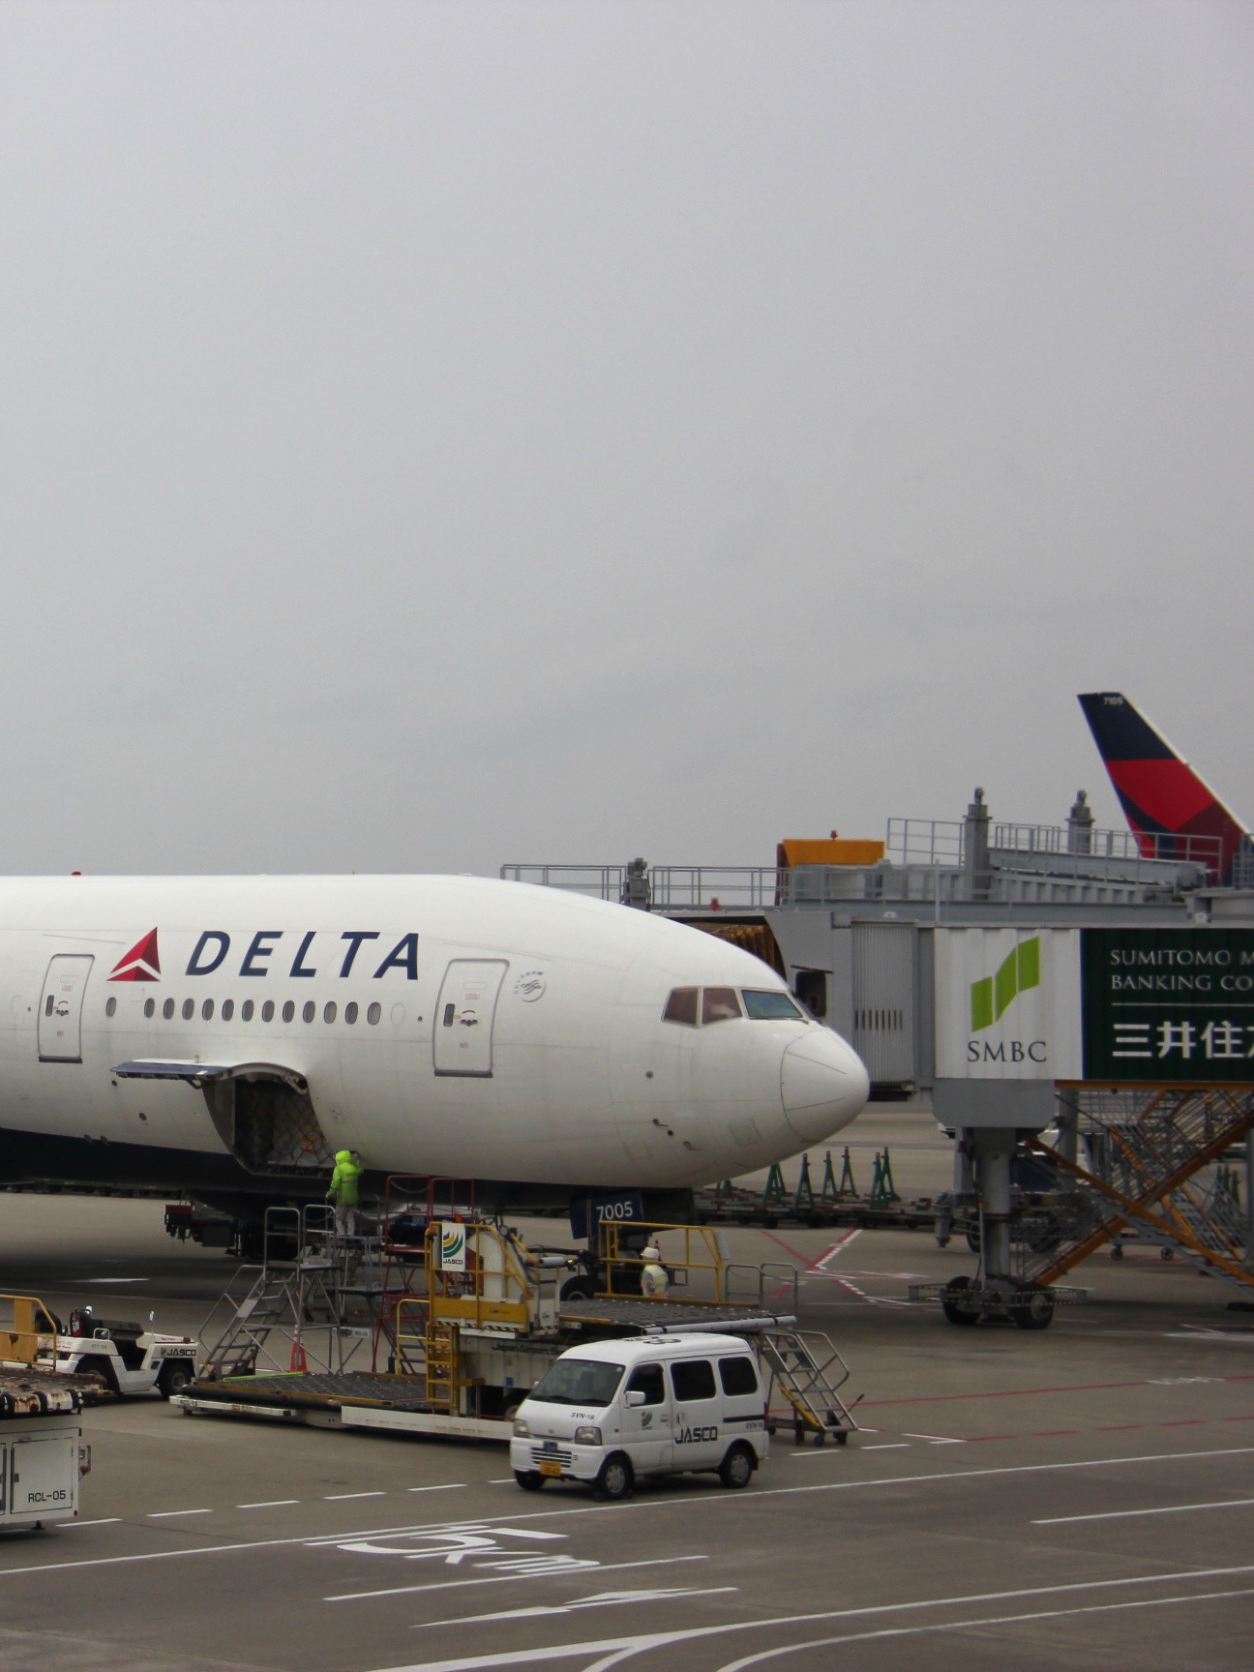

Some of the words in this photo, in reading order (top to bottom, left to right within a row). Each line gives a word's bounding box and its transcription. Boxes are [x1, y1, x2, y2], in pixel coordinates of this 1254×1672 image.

[185, 930, 419, 980] DELTA
[1110, 949, 1231, 966] SUMITOMO
[1111, 974, 1212, 991] BANKING
[1112, 1020, 1254, 1059] 三井住
[967, 1040, 1048, 1063] SMBC
[596, 1201, 633, 1221] 7005
[166, 1348, 196, 1357] JASCO
[674, 1426, 718, 1444] JASCO
[28, 1490, 66, 1503] RCL-05
